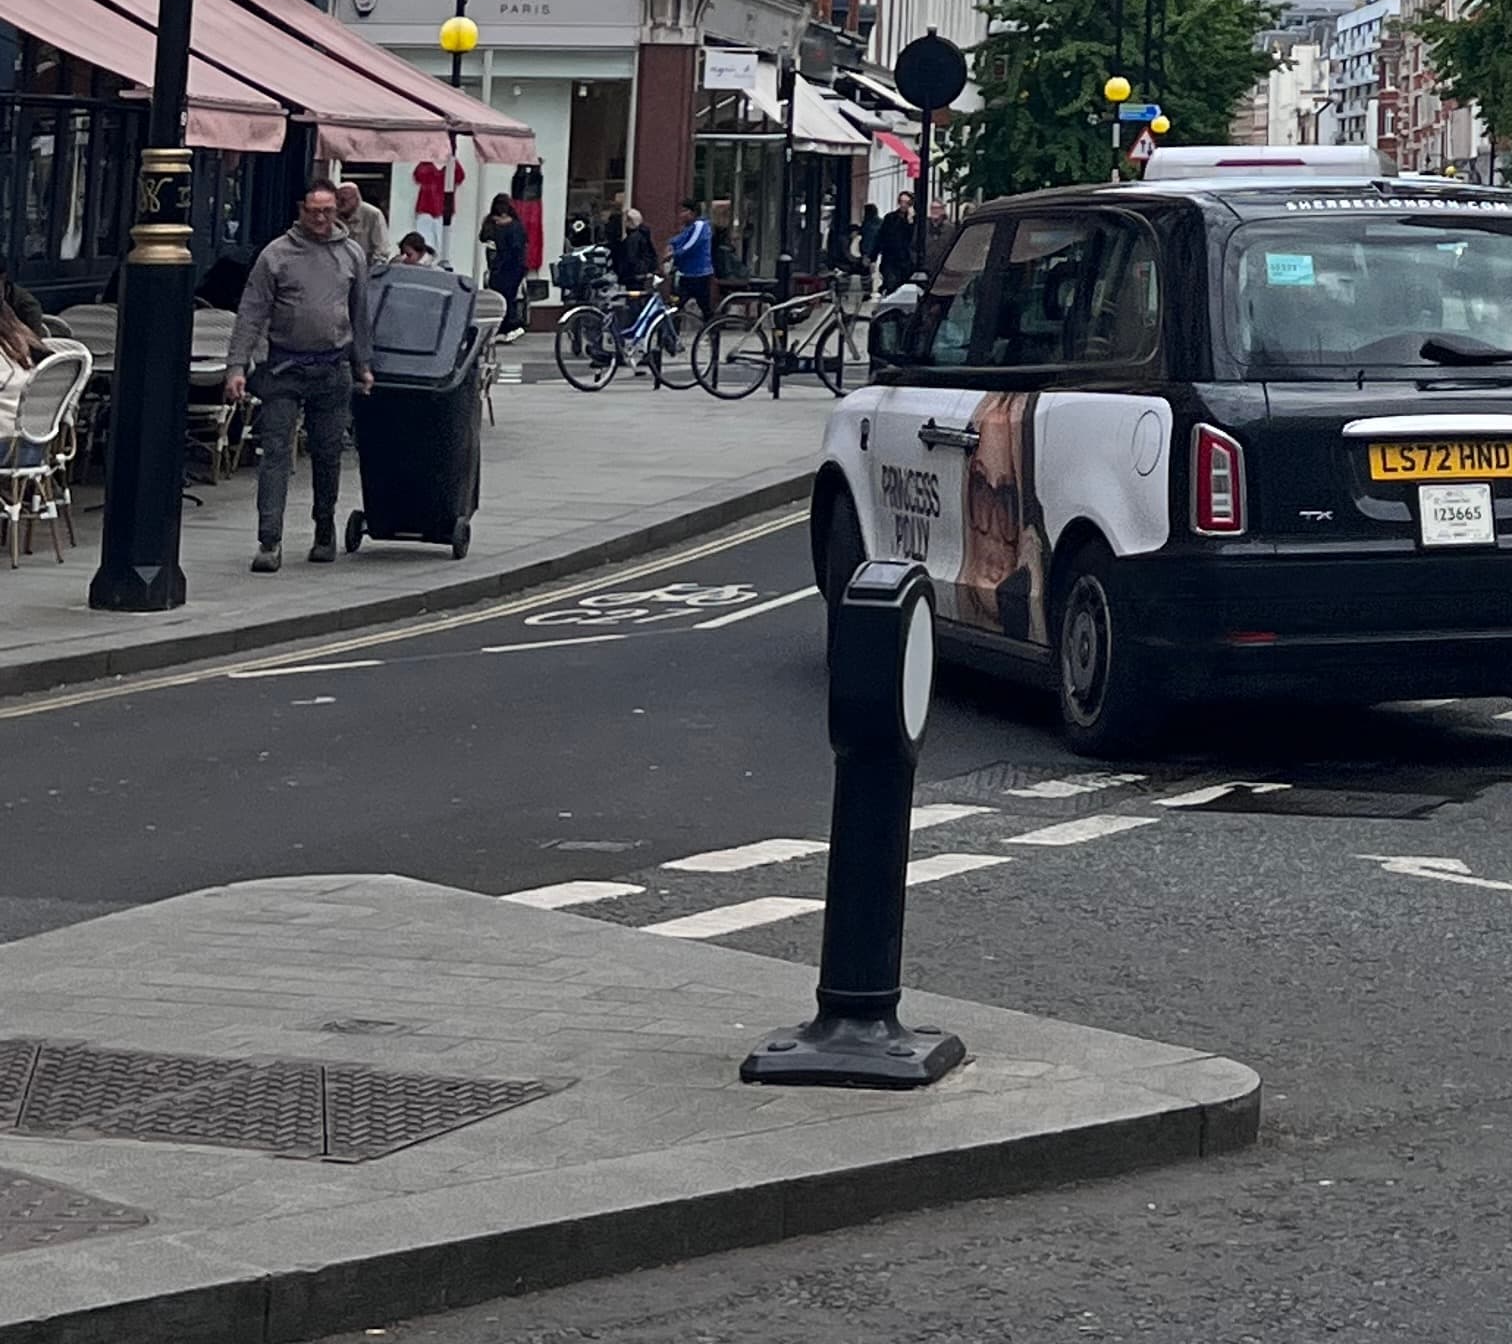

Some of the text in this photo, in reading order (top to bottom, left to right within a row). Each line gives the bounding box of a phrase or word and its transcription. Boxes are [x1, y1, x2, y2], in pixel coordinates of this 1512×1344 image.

[500, 4, 551, 15] PARIS
[1285, 197, 1510, 212] SHERBETLONDON.COM
[1381, 441, 1511, 473] LS72 HND
[881, 463, 941, 519] PRINCESS
[1299, 510, 1334, 521] TX
[1432, 505, 1483, 522] 123665
[523, 608, 704, 626] C27
